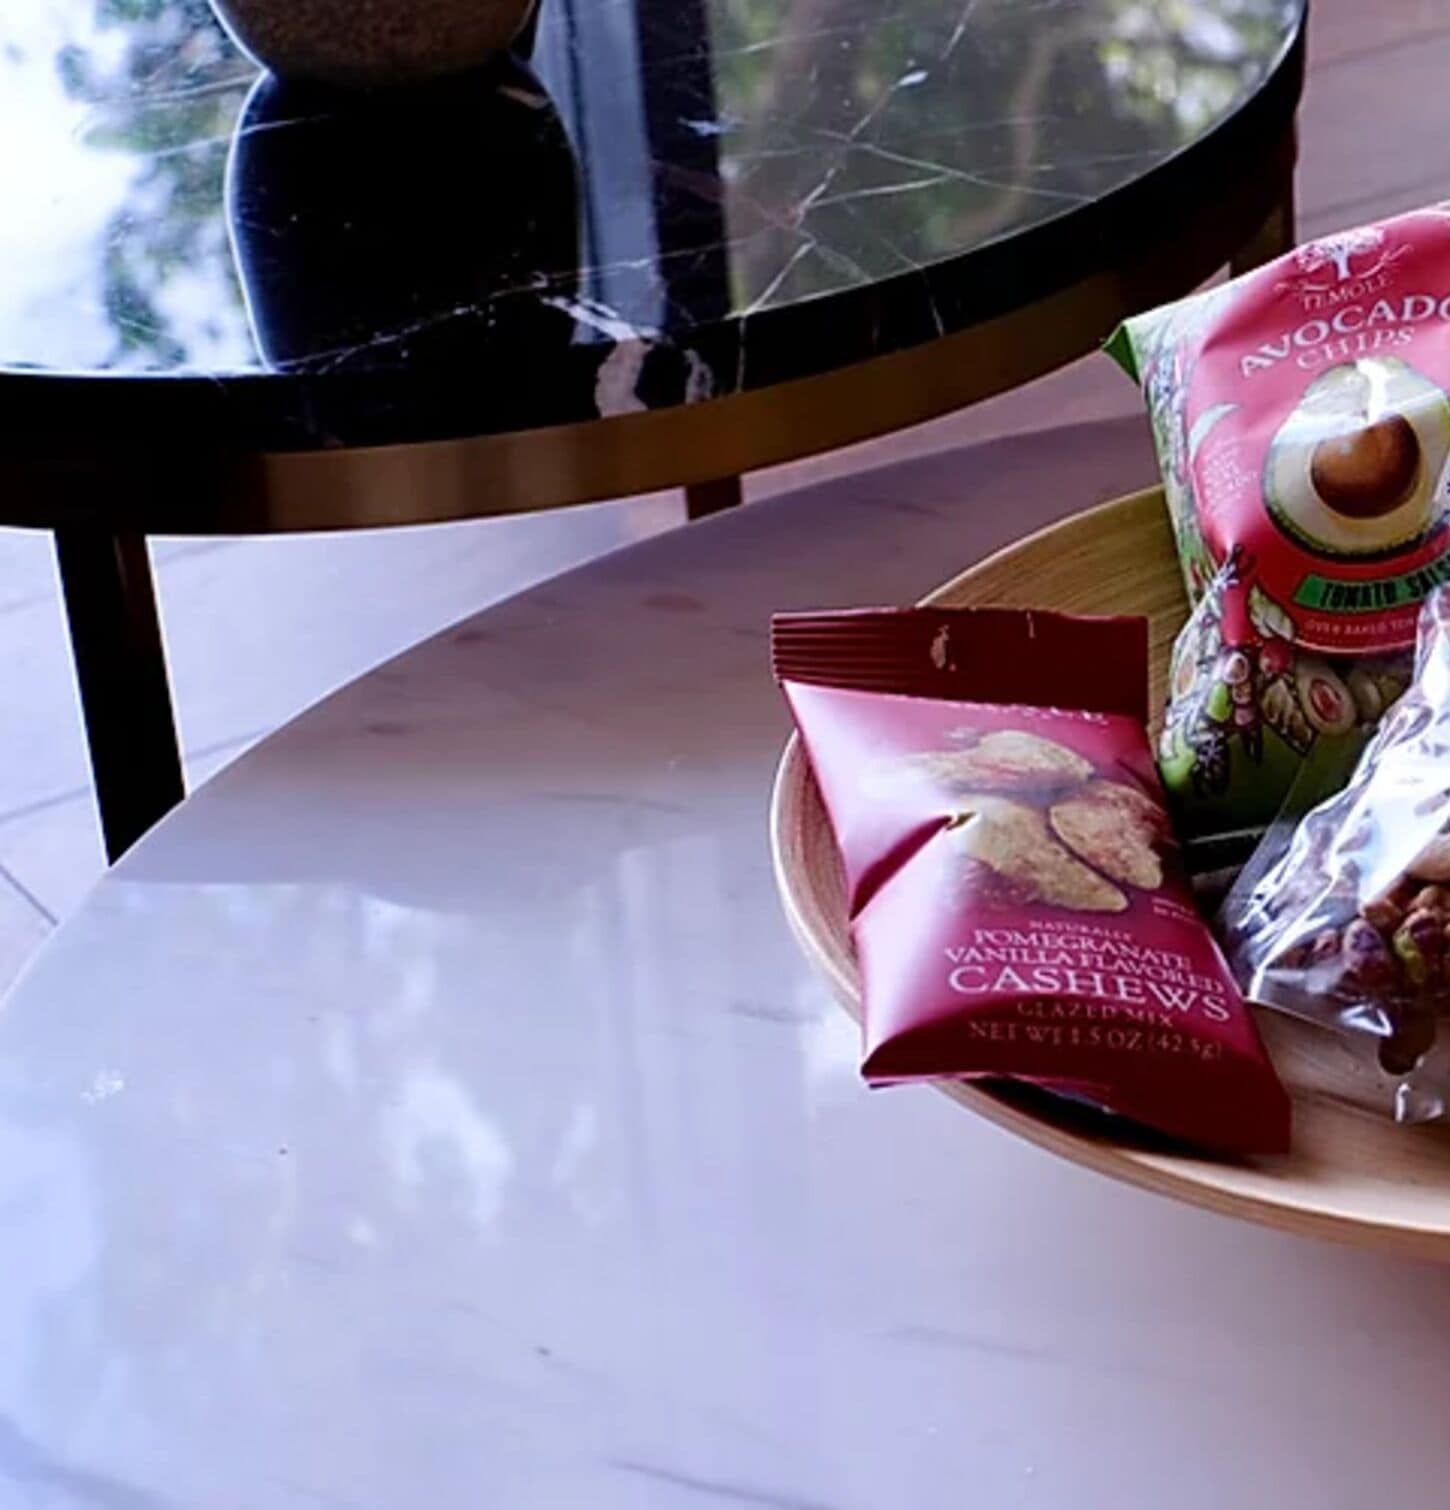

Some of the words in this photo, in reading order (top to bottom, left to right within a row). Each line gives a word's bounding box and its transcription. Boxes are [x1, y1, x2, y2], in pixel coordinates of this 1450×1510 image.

[1296, 326, 1416, 371] CHIPS
[1319, 581, 1398, 609] TOMATO
[1028, 919, 1134, 942] NATURALLY
[973, 928, 1192, 972] POMEGRANATE
[944, 946, 1076, 967] VANILLA
[1079, 953, 1226, 994] FLAVORED
[948, 965, 1231, 1022] CASHEWS
[1016, 1001, 1117, 1020] GLAZED
[1125, 1006, 1174, 1029] MIX
[967, 1020, 1019, 1042] NET
[1026, 1022, 1064, 1046] WT
[1106, 1029, 1143, 1051] OZ
